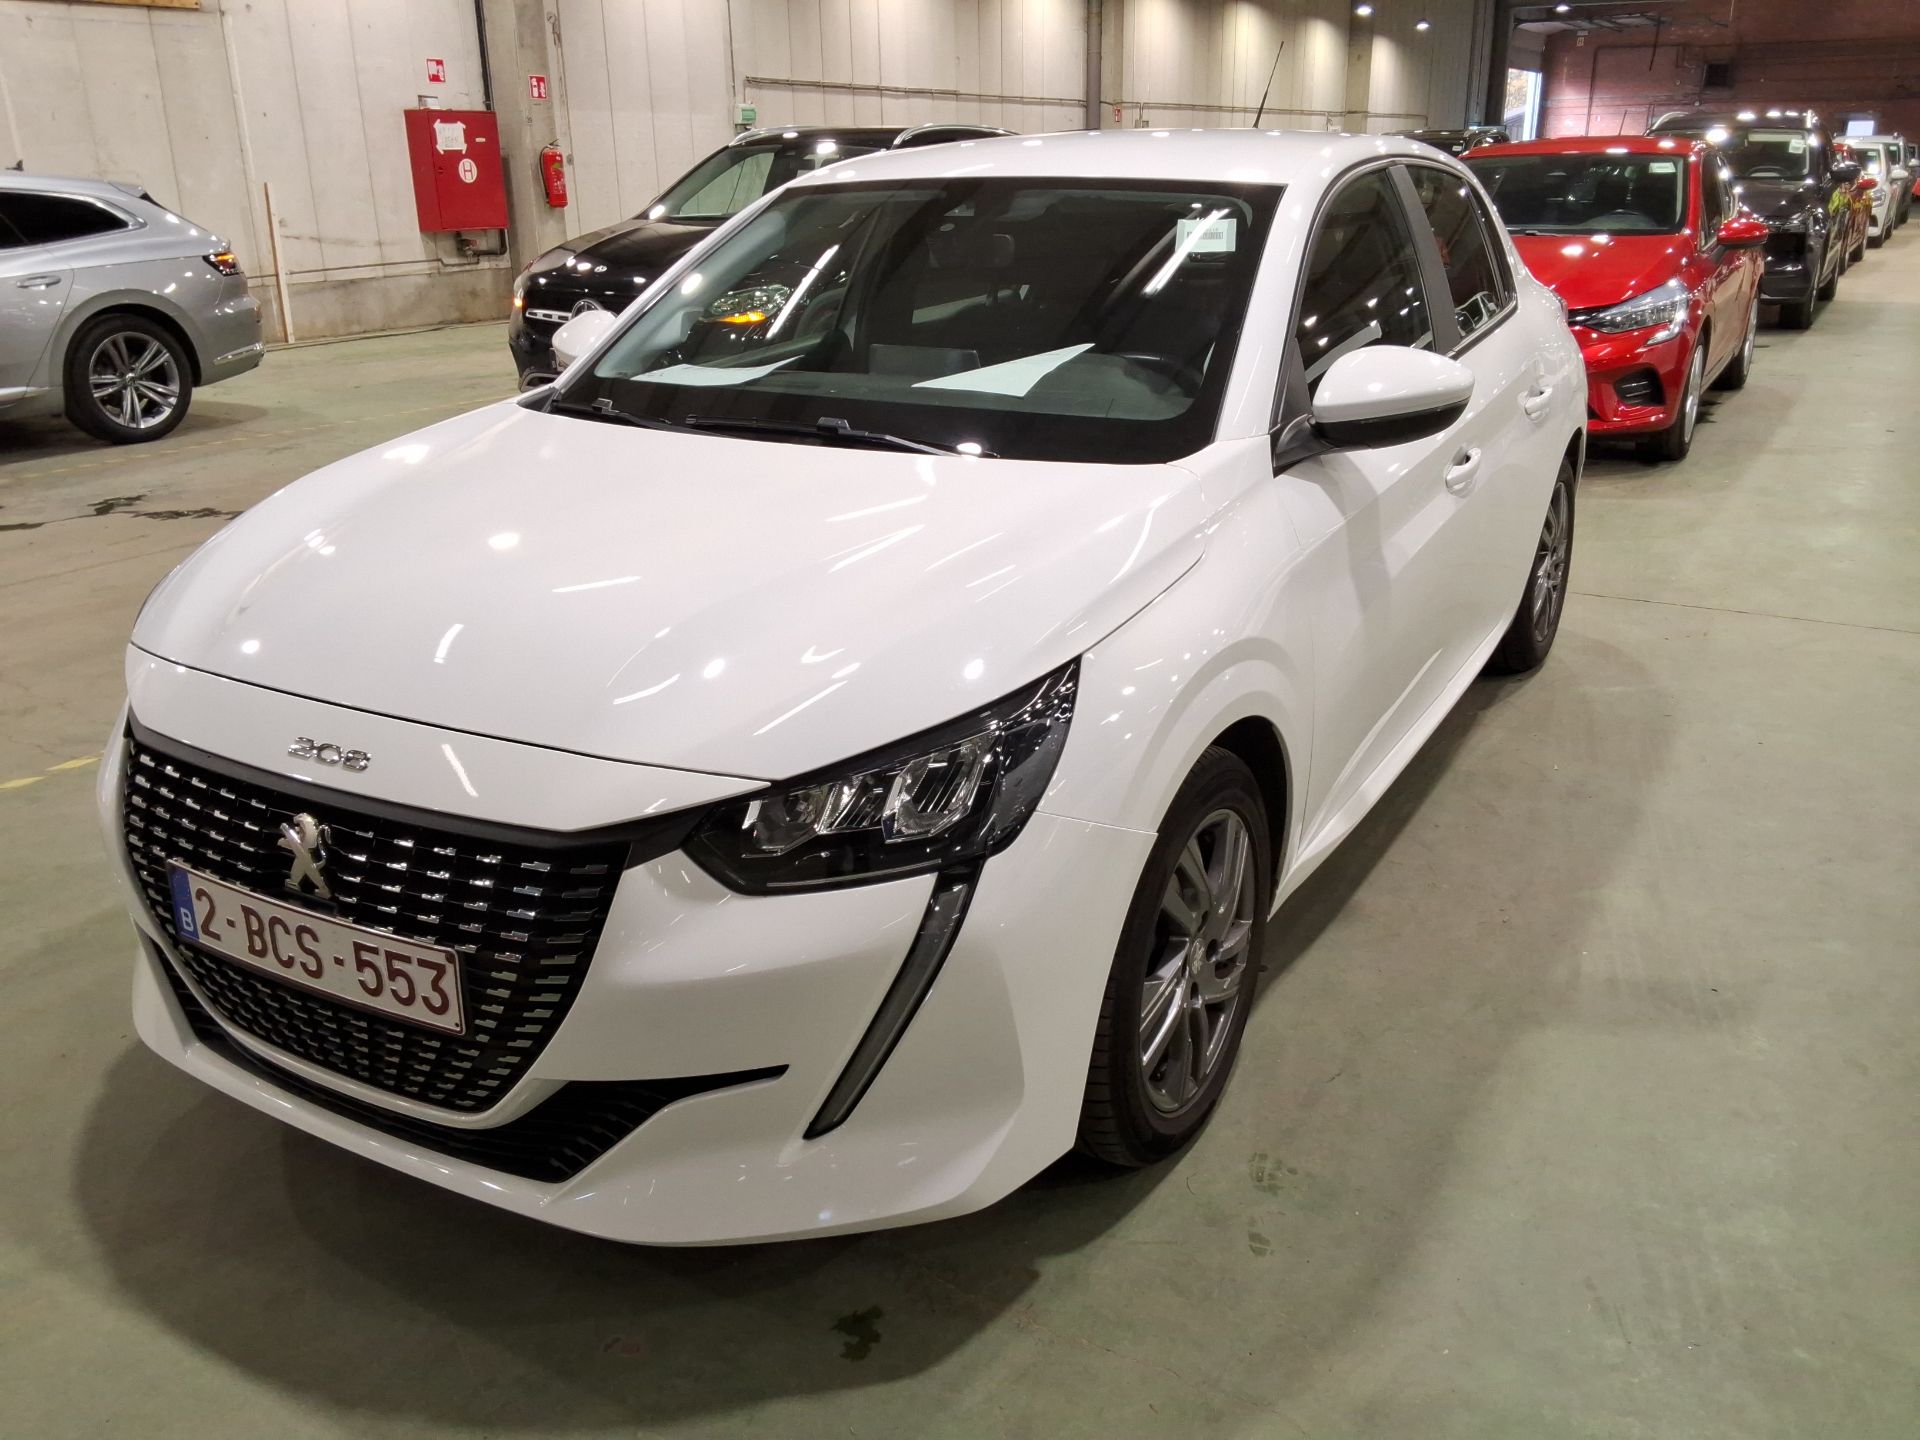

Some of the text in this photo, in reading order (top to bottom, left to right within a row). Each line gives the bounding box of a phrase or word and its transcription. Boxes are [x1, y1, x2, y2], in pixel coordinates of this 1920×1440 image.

[462, 161, 474, 180] H
[287, 736, 371, 772] 208
[180, 907, 195, 932] B
[195, 888, 450, 1016] 2-BCS-553
